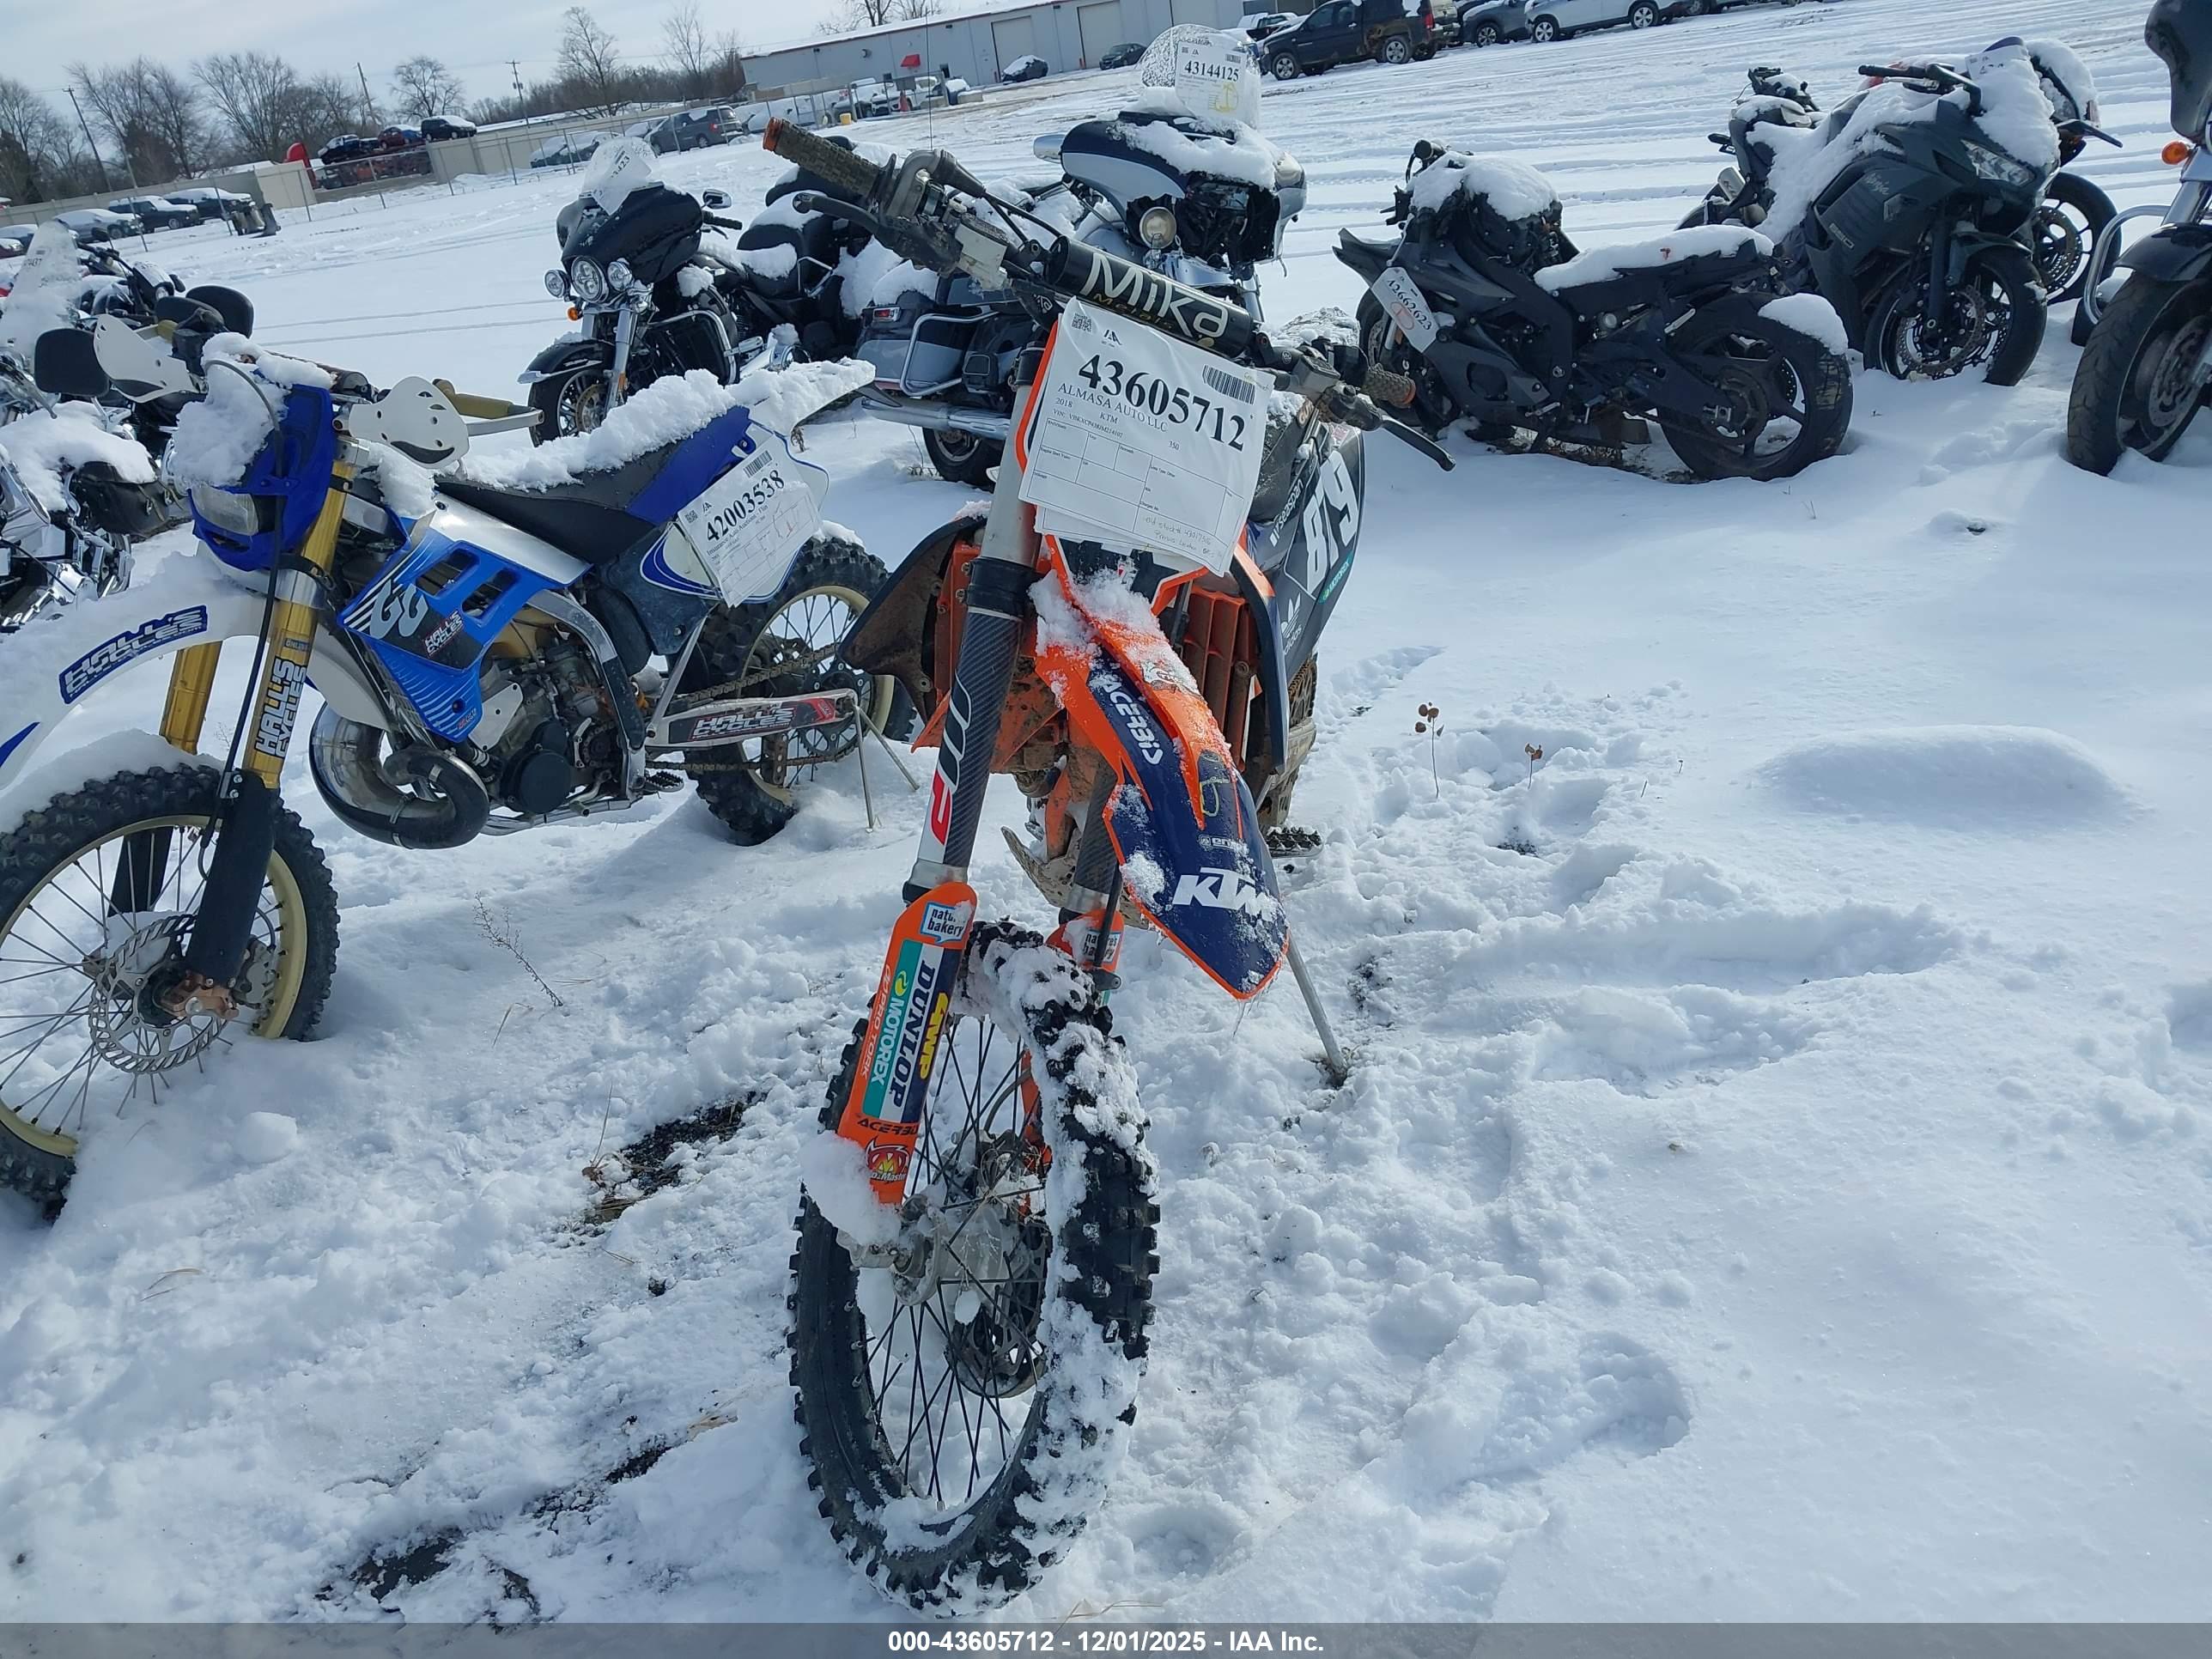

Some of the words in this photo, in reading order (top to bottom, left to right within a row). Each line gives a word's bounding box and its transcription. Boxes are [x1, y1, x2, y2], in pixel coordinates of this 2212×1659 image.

[1185, 60, 1239, 82] 43144125
[1387, 280, 1431, 330] 42662623
[1055, 398, 1073, 408] 2018
[1057, 383, 1112, 409] ALMASA
[1114, 402, 1146, 422] AUTO
[1146, 416, 1169, 432] LLC
[1079, 355, 1244, 452] 43605712
[1099, 411, 1118, 424] KTM
[1169, 441, 1180, 451] 350
[706, 470, 785, 543] 42003538
[707, 535, 728, 556] Insurance
[66, 617, 203, 694] CYCLES
[426, 619, 464, 656] CYCLES
[274, 665, 307, 758] CYCLES
[693, 716, 792, 736] CYCLES
[1172, 867, 1276, 922] KTM
[927, 918, 964, 937] bakery
[860, 1034, 878, 1080] TORK
[870, 997, 905, 1086] MOTOREX
[889, 960, 936, 1108] DUNLOP
